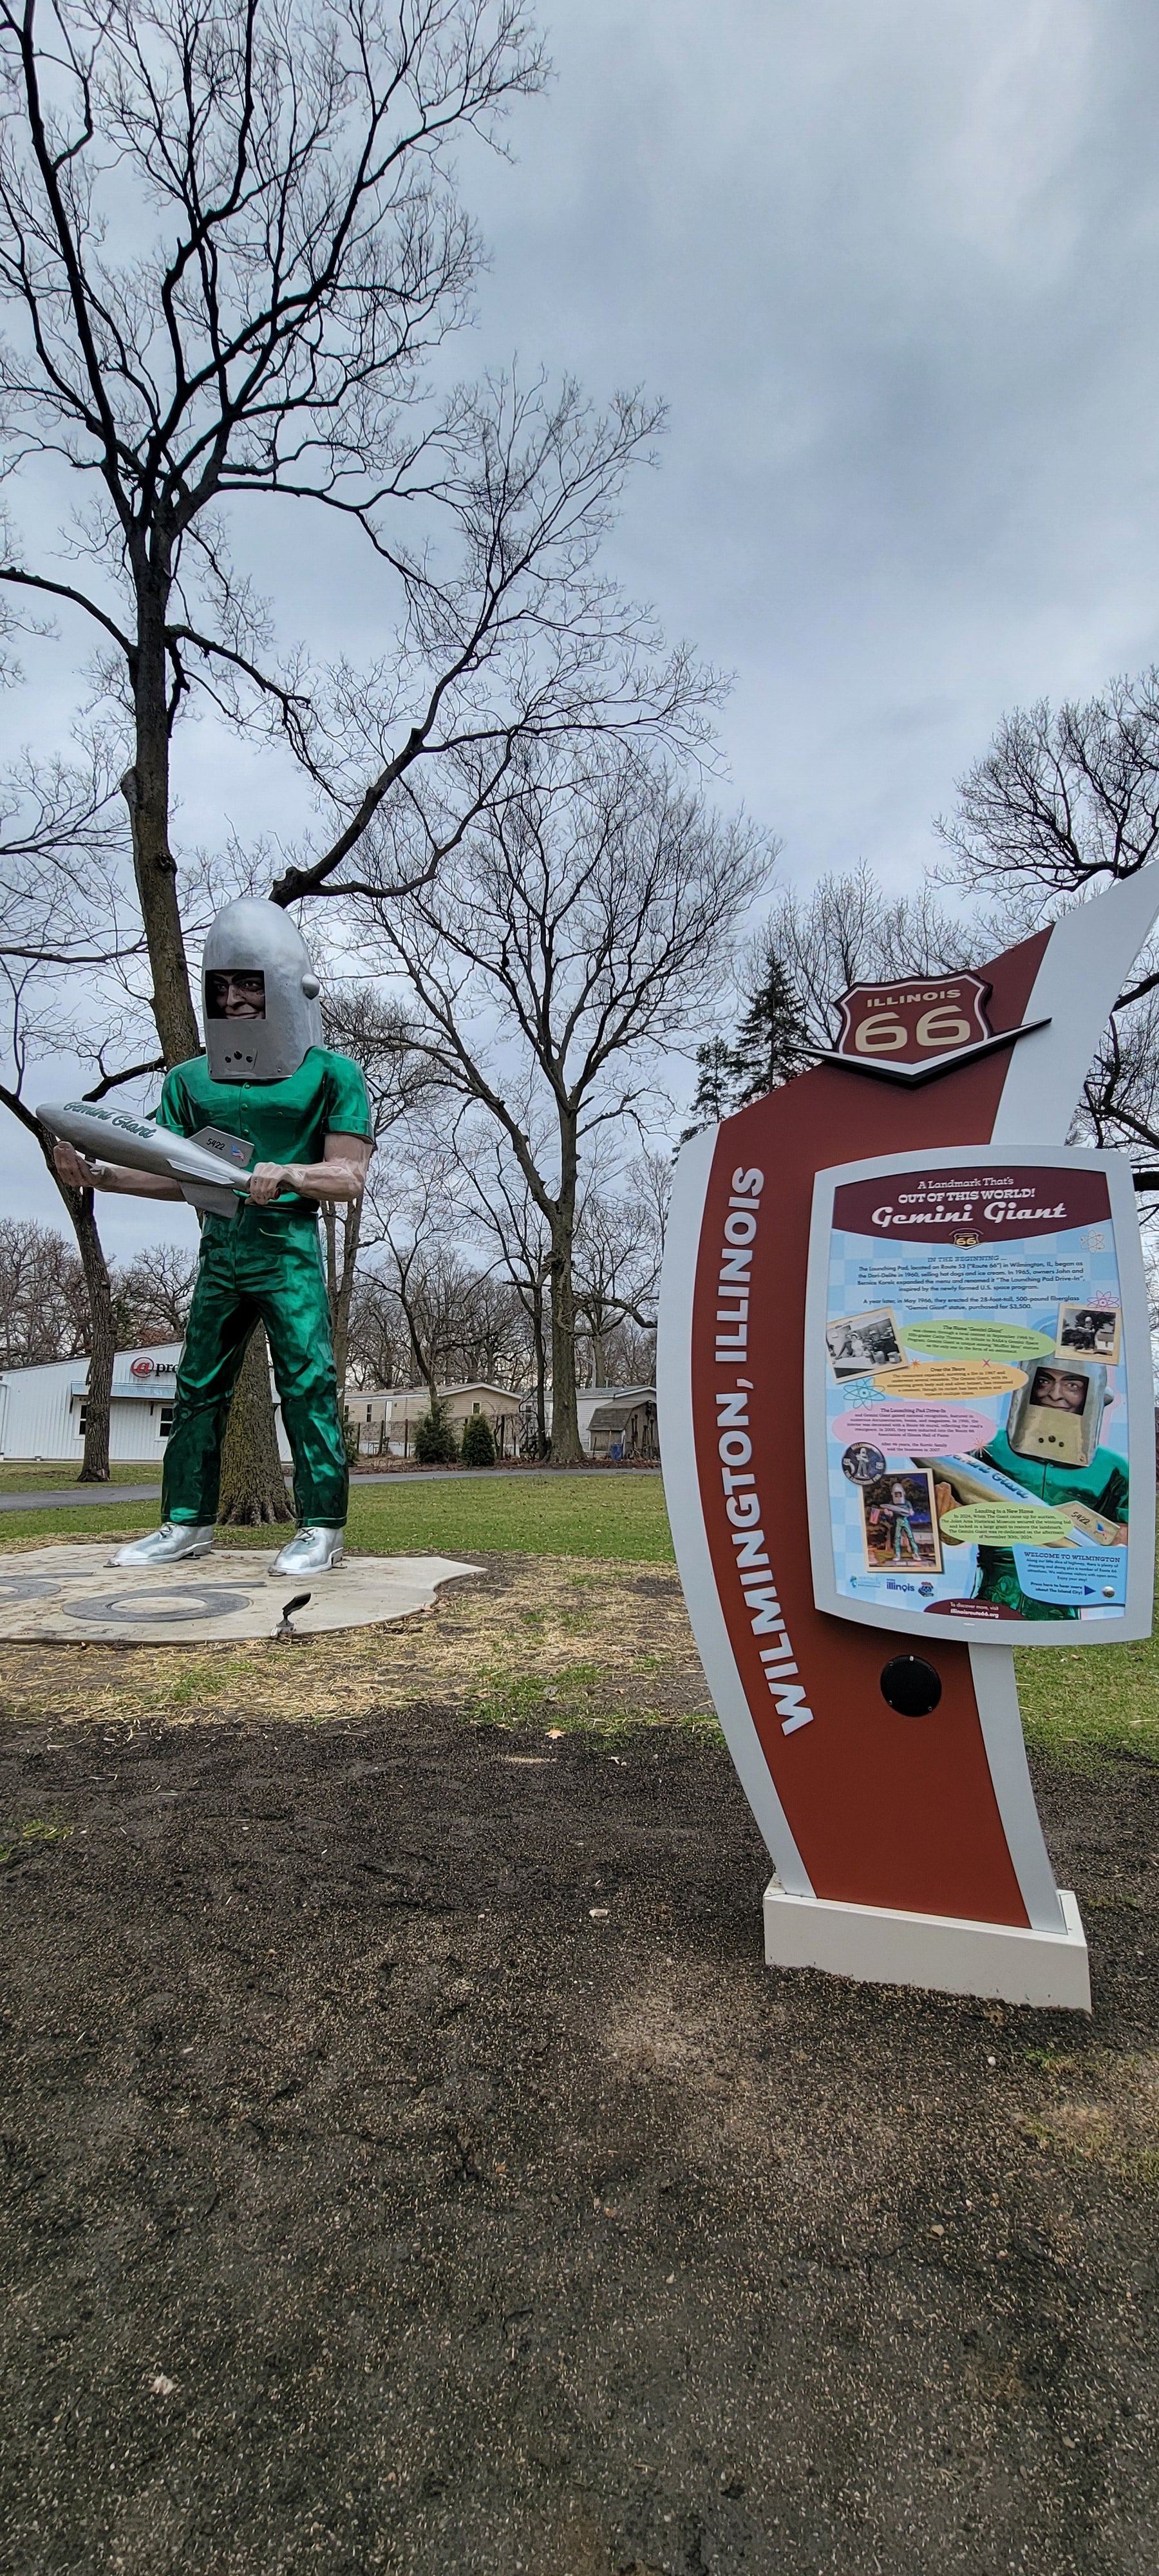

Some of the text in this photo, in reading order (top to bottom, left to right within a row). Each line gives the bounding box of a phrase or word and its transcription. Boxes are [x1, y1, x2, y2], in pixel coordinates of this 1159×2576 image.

[867, 989, 961, 1008] ILLINOIS
[855, 1005, 971, 1053] 66
[63, 1101, 157, 1139] Gemini Giant
[206, 1137, 225, 1151] 5422
[928, 1178, 981, 1189] Landmark
[983, 1177, 1014, 1186] That's
[898, 1188, 1035, 1204] OUT OF THIS WORLD!
[871, 1201, 1067, 1227] Gemini Giant
[956, 1237, 977, 1245] 66
[715, 1166, 814, 1736] WILMINGTON, ILLINOIS
[1071, 1511, 1090, 1526] 5422
